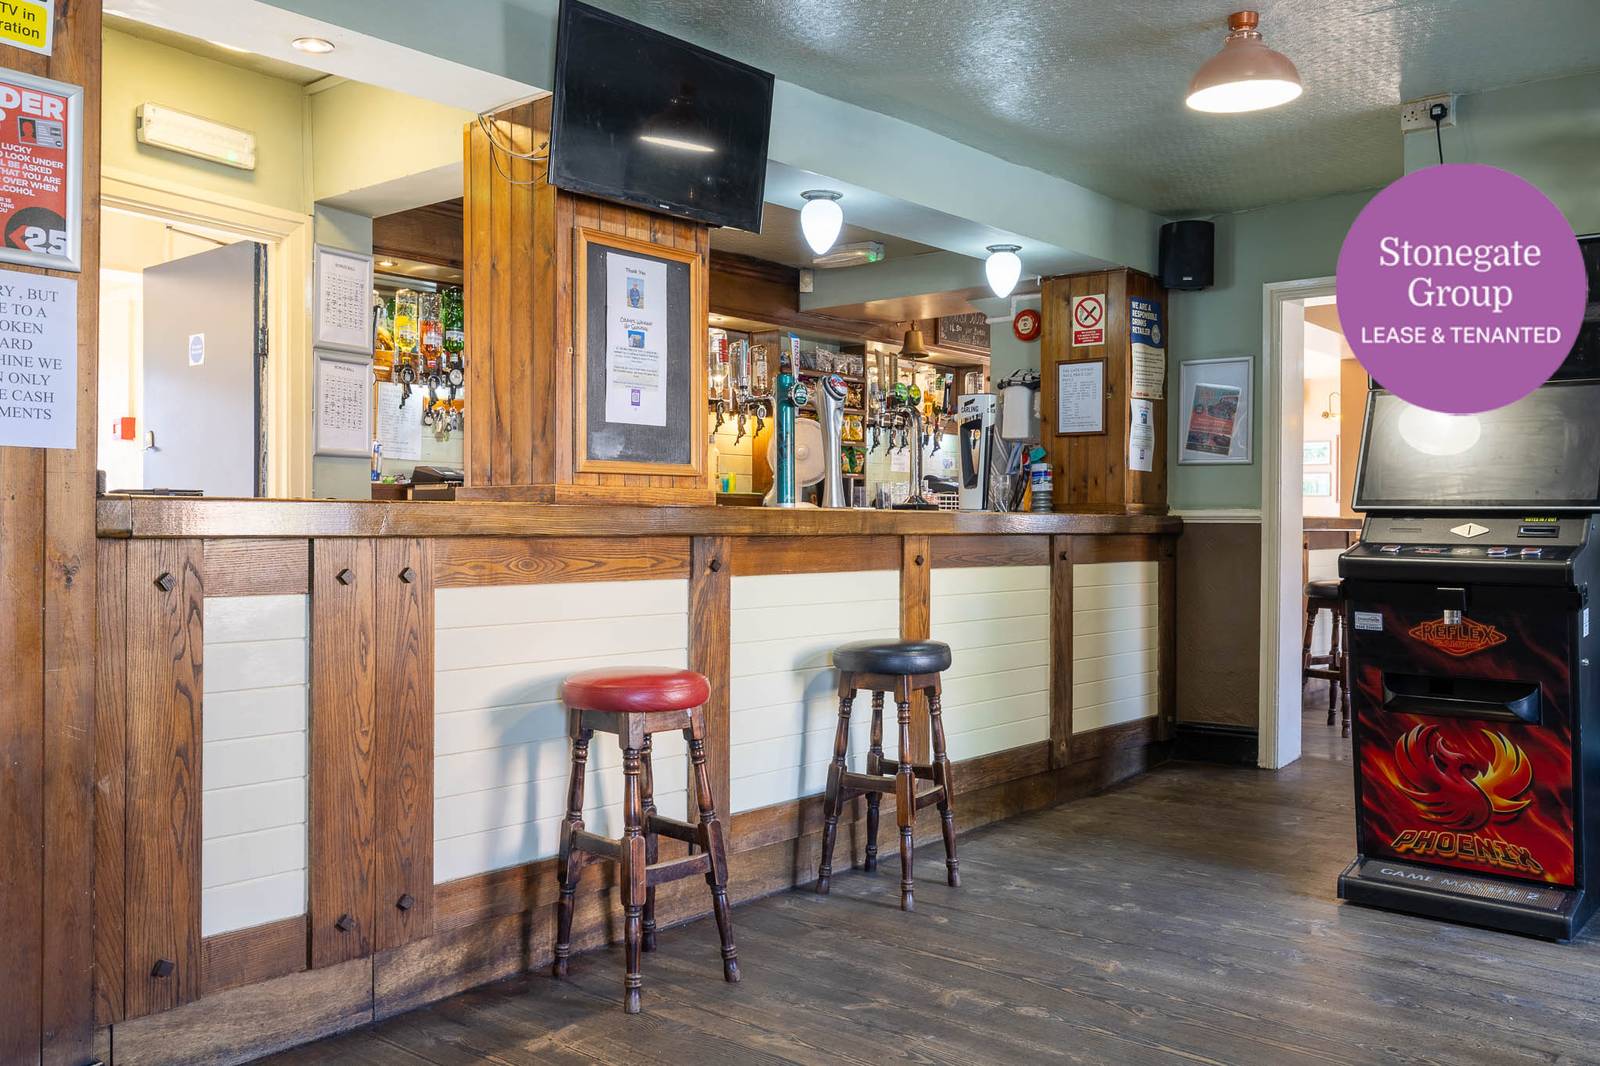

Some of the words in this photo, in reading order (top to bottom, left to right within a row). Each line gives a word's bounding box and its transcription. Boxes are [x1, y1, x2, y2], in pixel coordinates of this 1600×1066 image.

[23, 8, 35, 22] in
[1, 142, 32, 154] LUCKY
[5, 151, 31, 163] LOOK
[32, 156, 64, 169] UNDER
[8, 160, 20, 169] BE
[22, 163, 53, 175] ASKED
[3, 176, 29, 187] OVER
[30, 180, 59, 193] WHEN
[22, 170, 41, 181] YOU
[42, 175, 62, 185] ARE
[28, 288, 59, 302] BUT
[11, 303, 33, 317] TO
[36, 306, 47, 318] A
[38, 357, 63, 370] WE
[9, 372, 50, 386] ONLY
[12, 390, 54, 403] CASH
[961, 405, 979, 414] CARLING
[1421, 622, 1496, 645] REFLEX
[1391, 829, 1544, 873] PHOENIX
